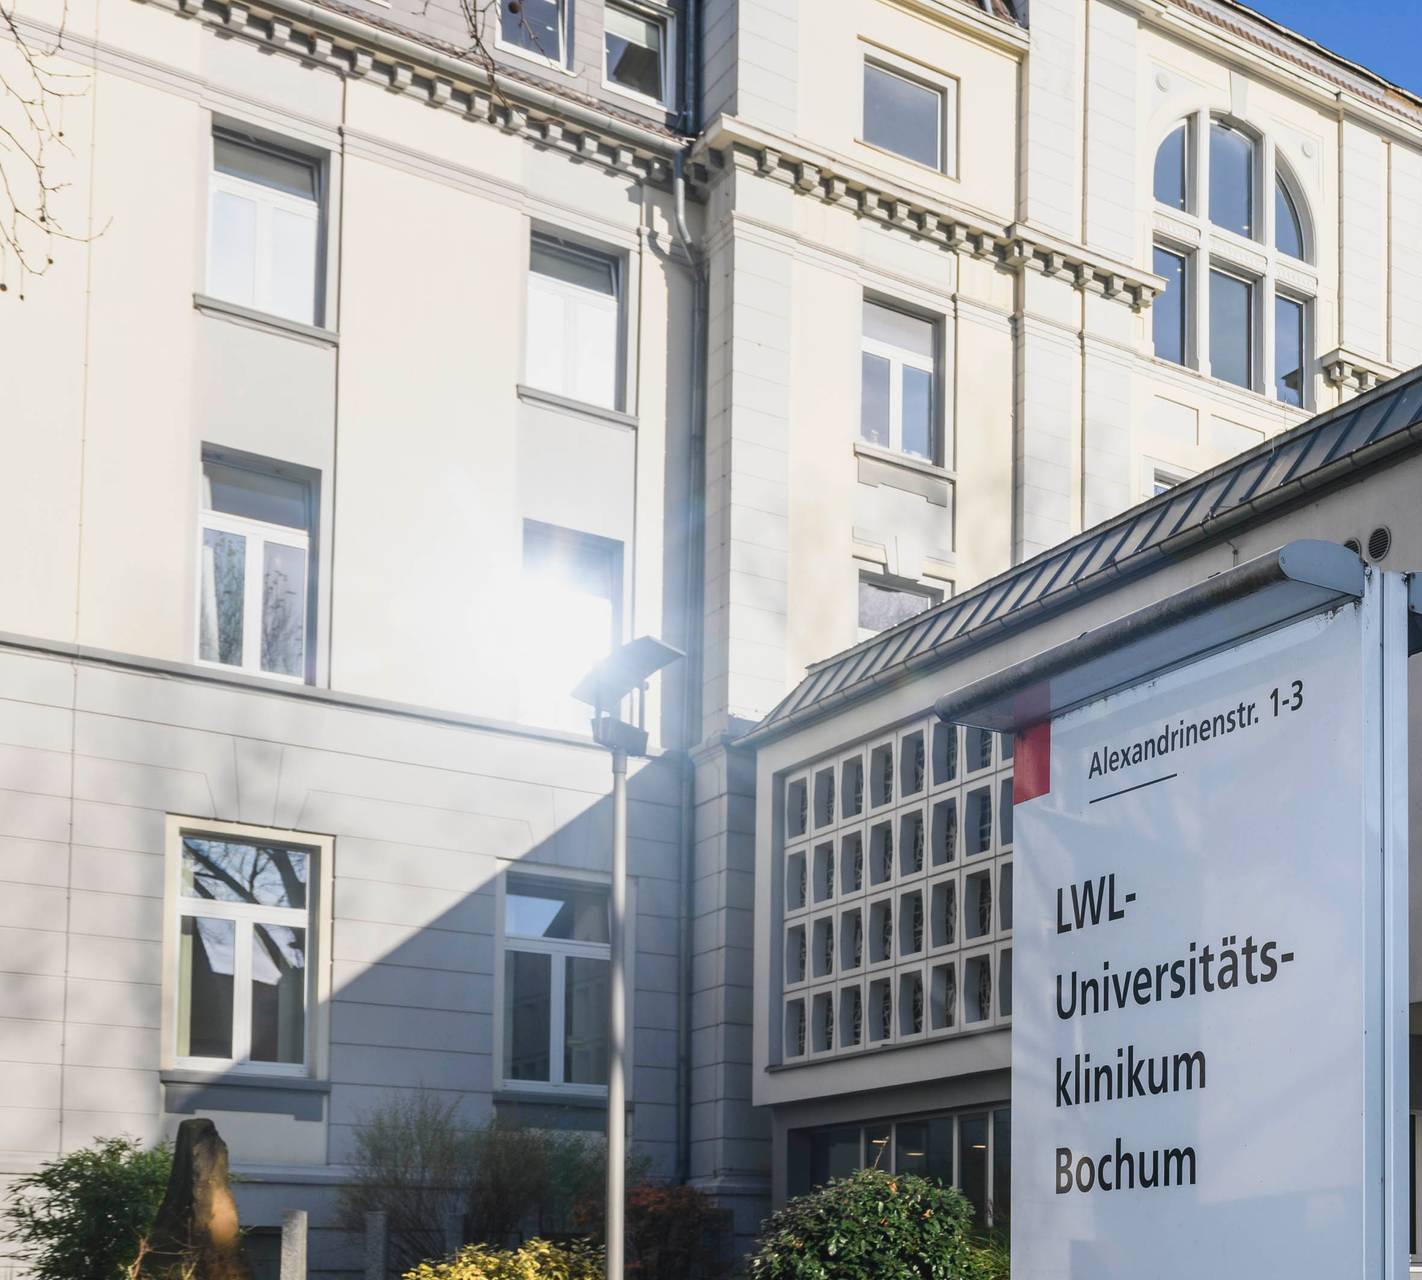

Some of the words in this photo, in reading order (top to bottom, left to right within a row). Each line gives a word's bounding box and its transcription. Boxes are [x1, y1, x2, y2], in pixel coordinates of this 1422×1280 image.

[1088, 702, 1259, 780] Alexandrinenstr.
[1269, 680, 1304, 717] 1-3
[1056, 873, 1137, 935] LWL-
[1056, 935, 1296, 1020] Universitäts-
[1055, 1044, 1206, 1108] klinikum
[1055, 1137, 1197, 1195] Bochum
